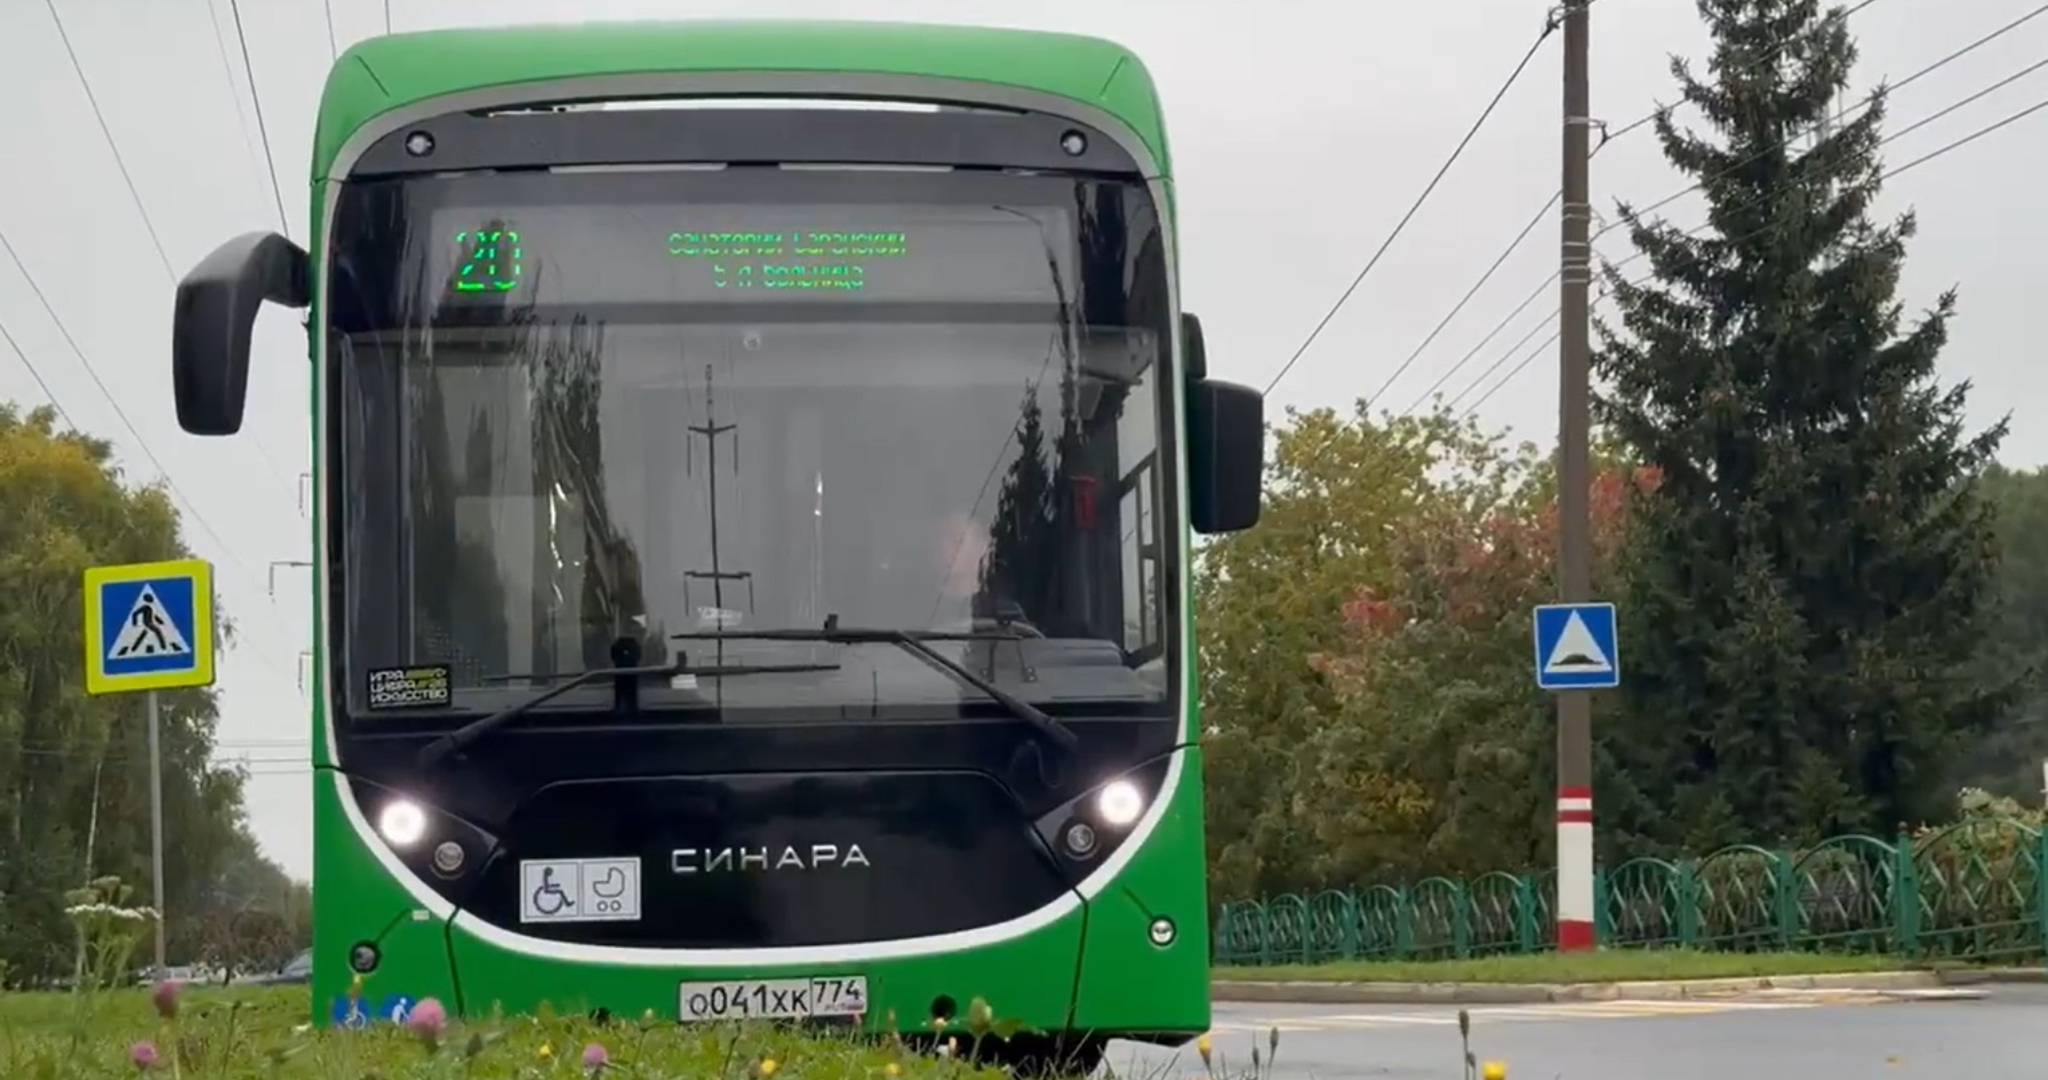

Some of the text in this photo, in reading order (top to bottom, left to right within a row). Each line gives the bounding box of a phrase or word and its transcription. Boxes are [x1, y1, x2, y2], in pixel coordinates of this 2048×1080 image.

[456, 230, 520, 290] 20
[370, 688, 449, 704] ИСКУССТВО
[671, 843, 871, 874] СИНАРА
[813, 979, 861, 1003] 774
